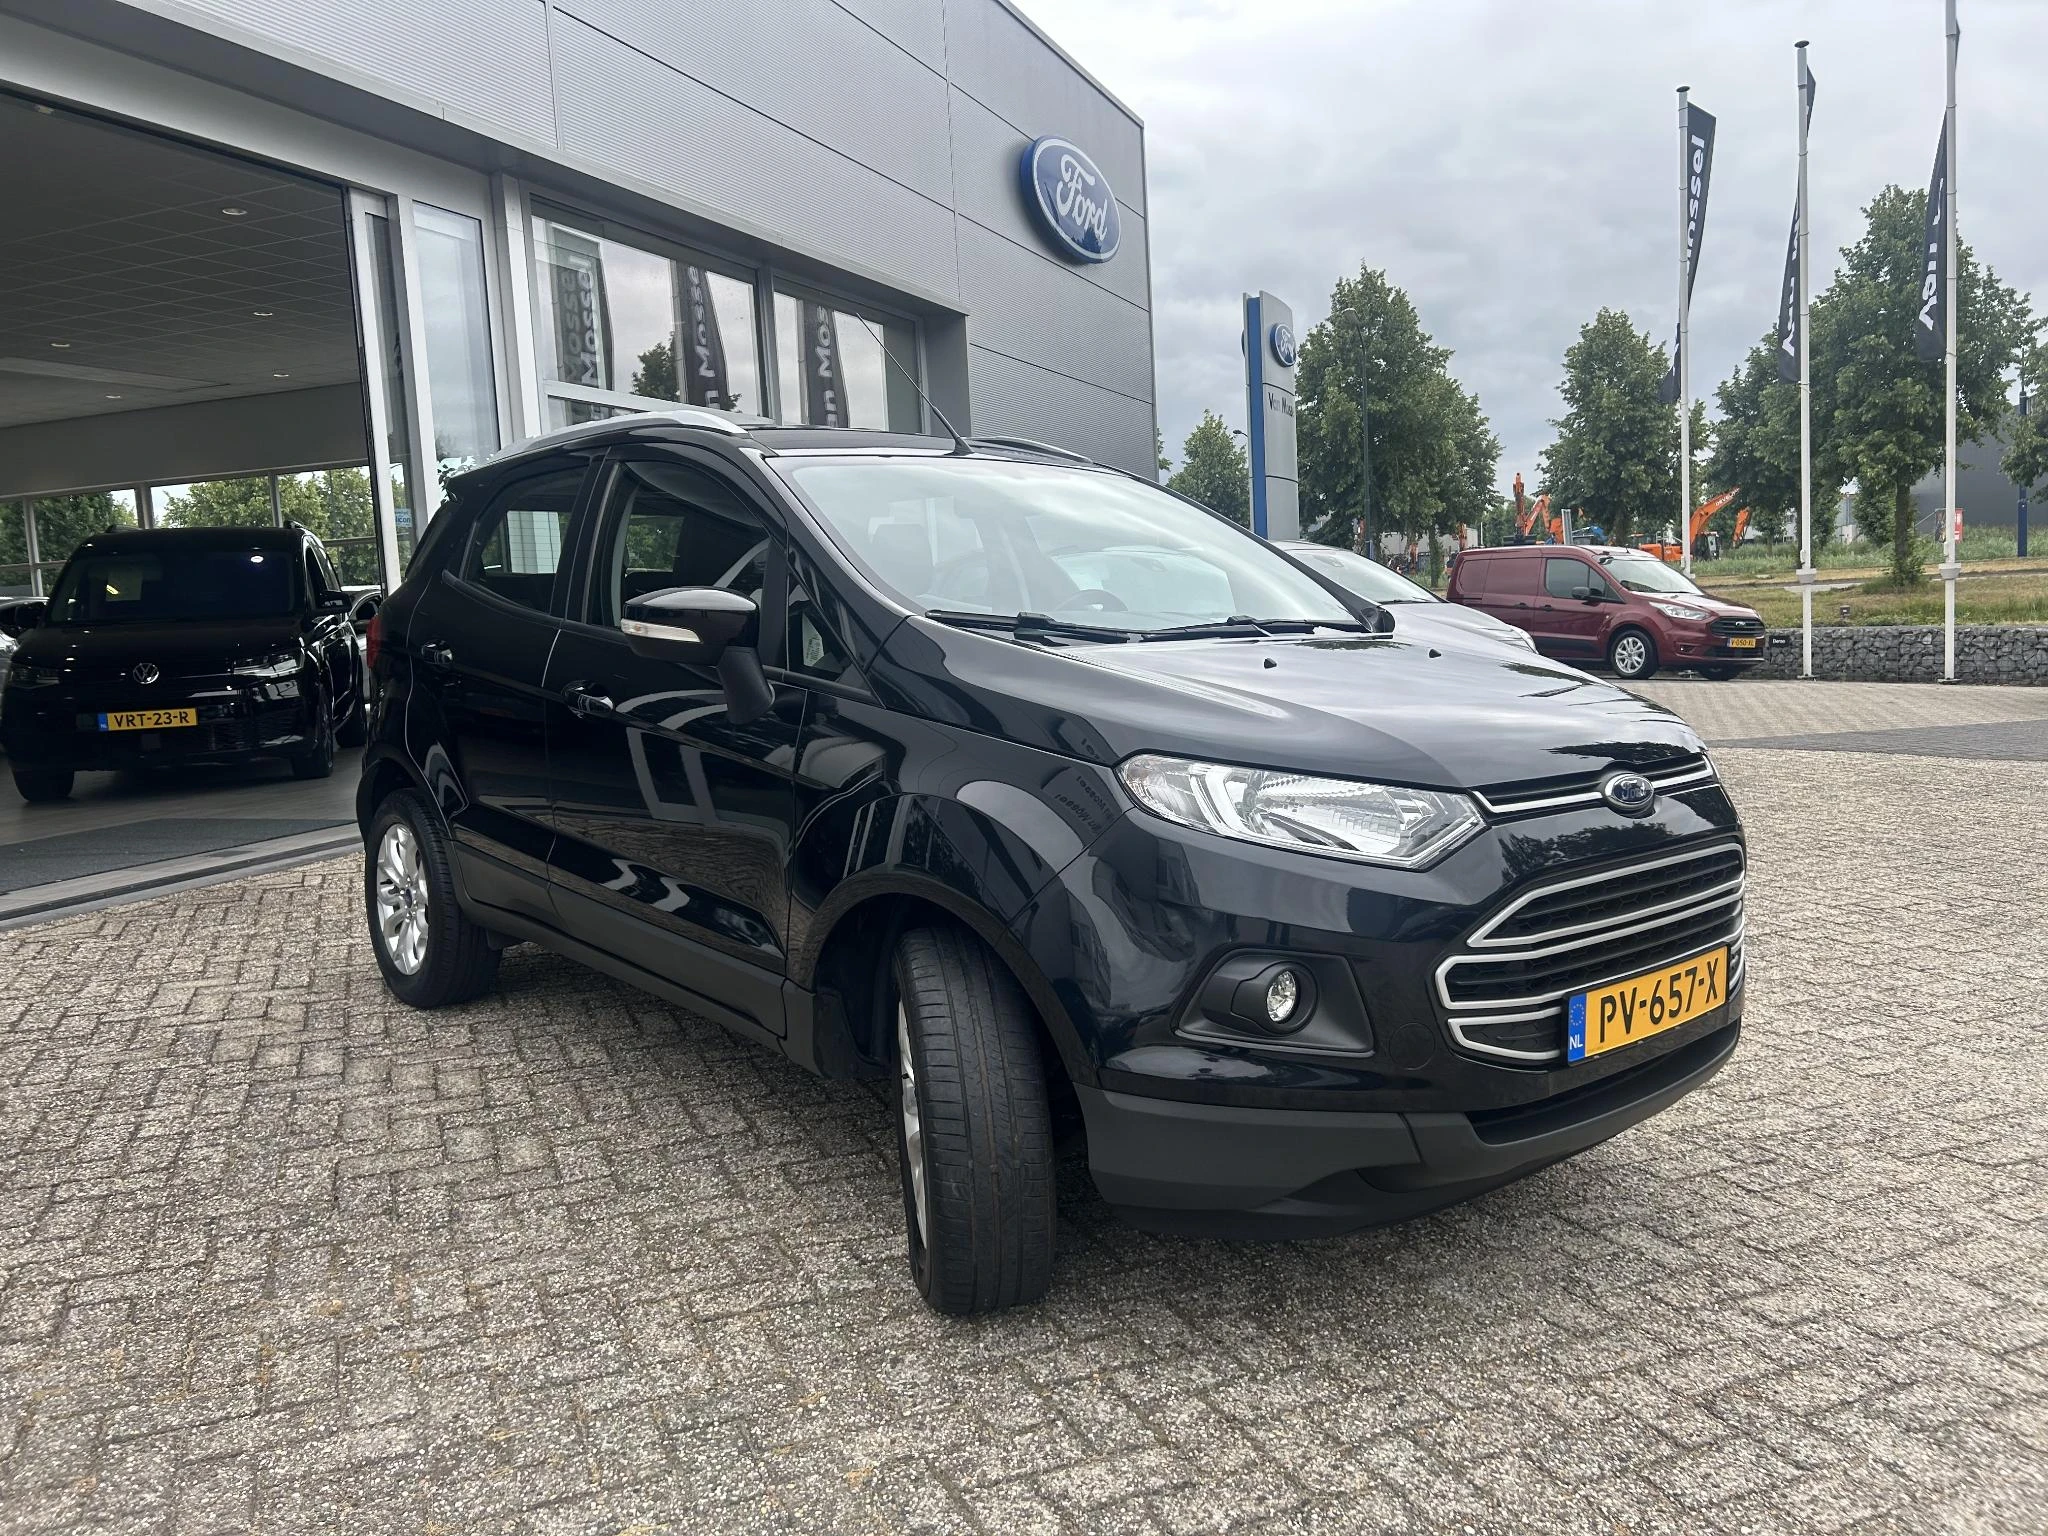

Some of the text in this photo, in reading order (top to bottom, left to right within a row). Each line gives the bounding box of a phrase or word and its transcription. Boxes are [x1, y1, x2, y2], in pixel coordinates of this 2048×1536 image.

[1056, 154, 1108, 243] Ford
[1687, 134, 1705, 262] ossel
[688, 265, 716, 378] Mosse
[113, 711, 190, 728] VRT-23-R
[1620, 779, 1646, 800] Ford
[1569, 957, 1719, 1050] NL PV-657-X
